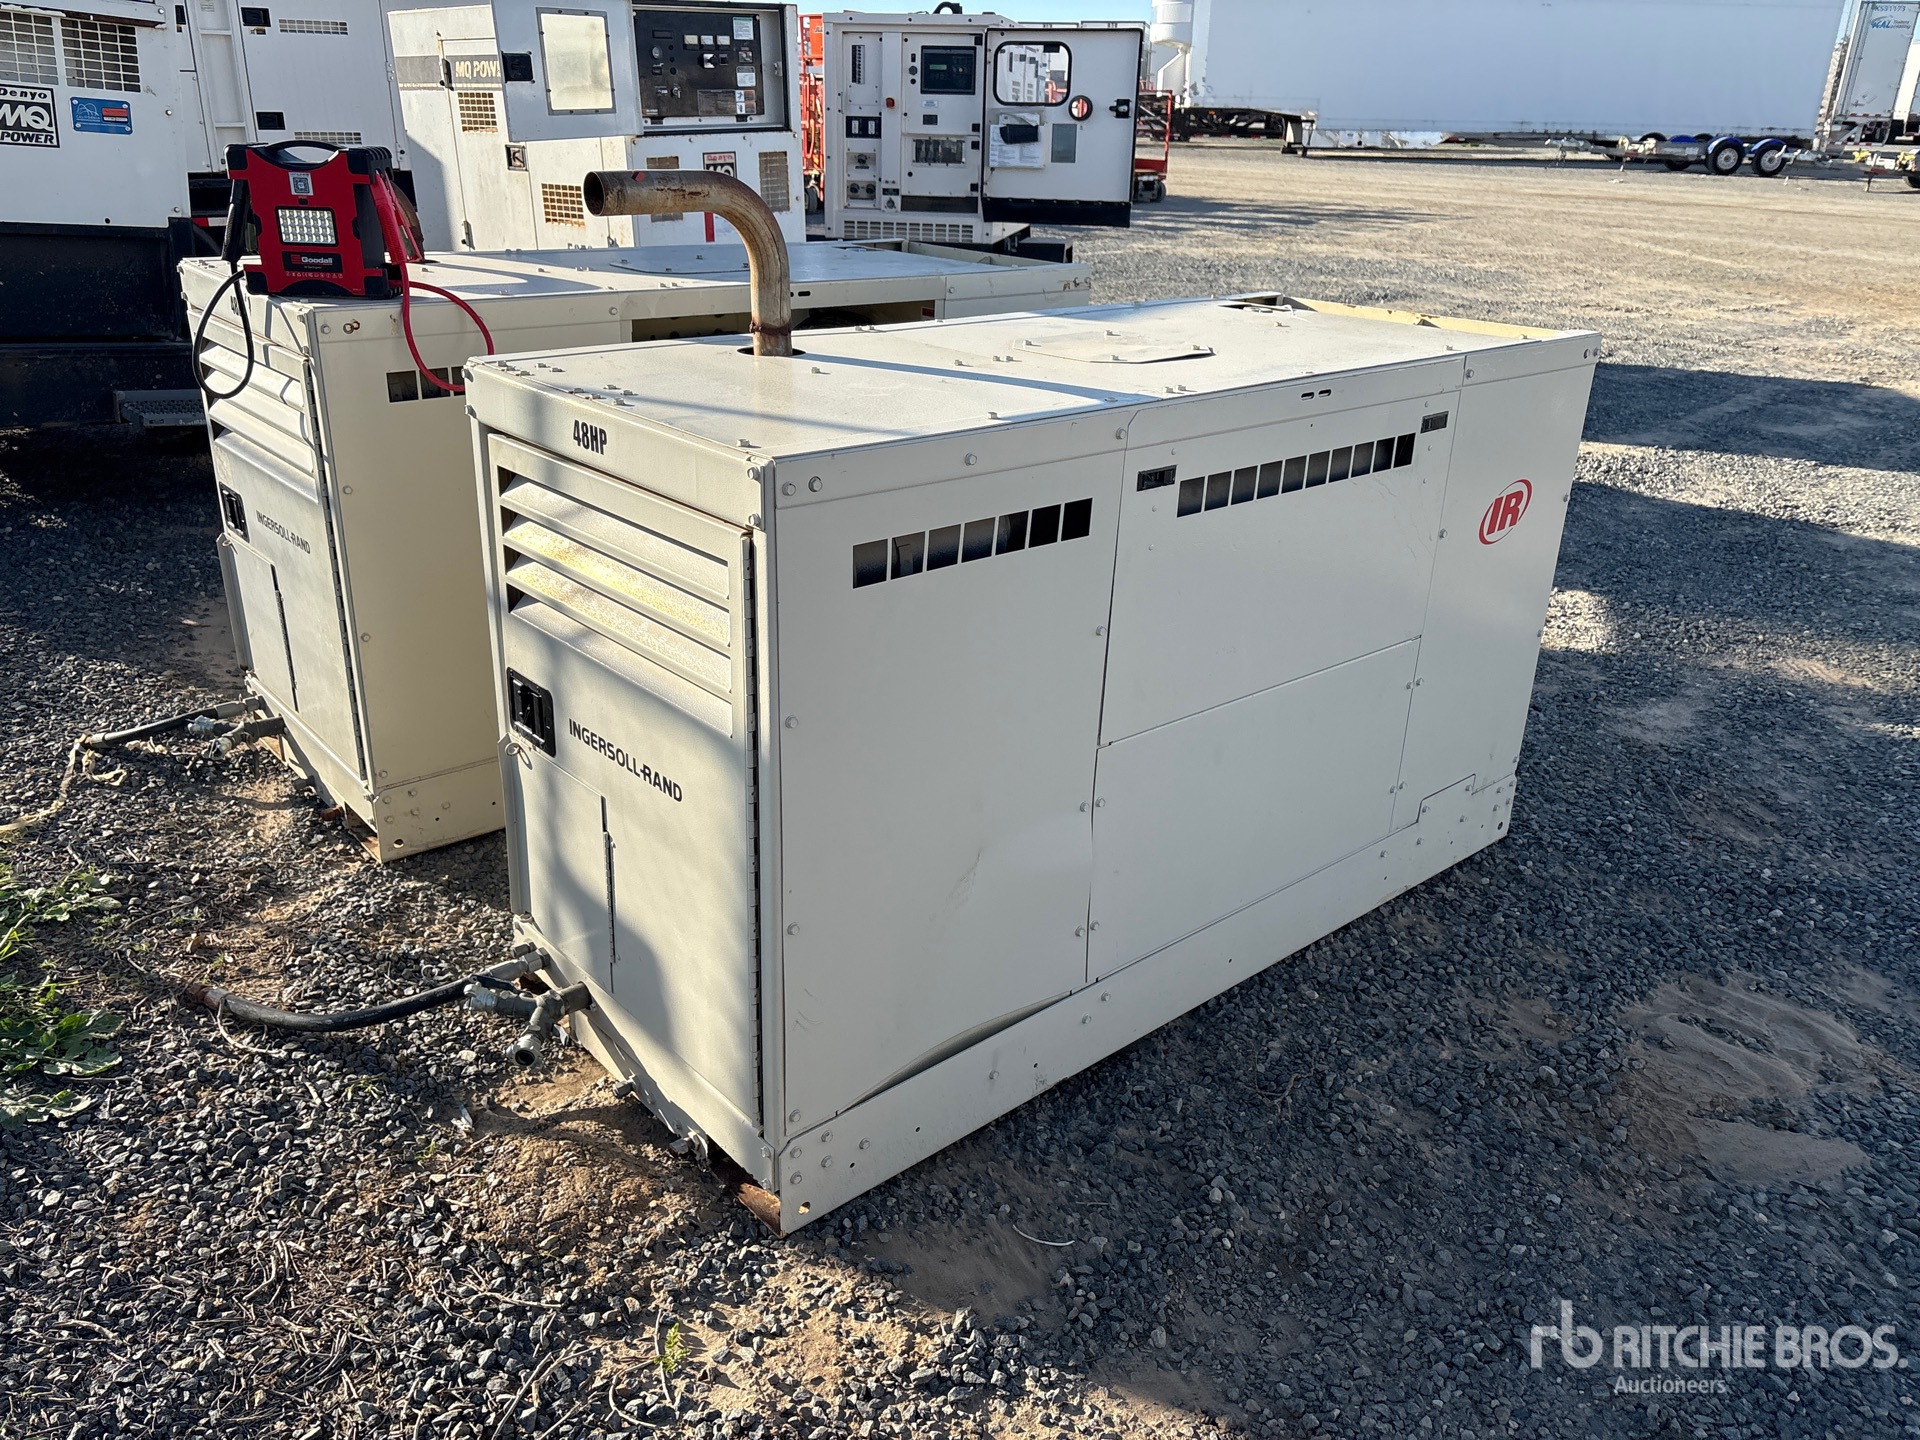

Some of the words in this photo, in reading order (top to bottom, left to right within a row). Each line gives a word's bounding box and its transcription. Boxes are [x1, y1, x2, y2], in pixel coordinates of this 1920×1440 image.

[455, 60, 472, 80] MQ
[0, 88, 48, 101] Denyo
[0, 103, 54, 132] MQ
[0, 131, 55, 144] POWER
[301, 256, 333, 264] Goodall
[573, 419, 607, 455] 48HP
[1486, 490, 1523, 535] IR
[256, 510, 311, 554] INGERSOLL-RAND
[568, 718, 683, 803] INGERSOLL-RAND
